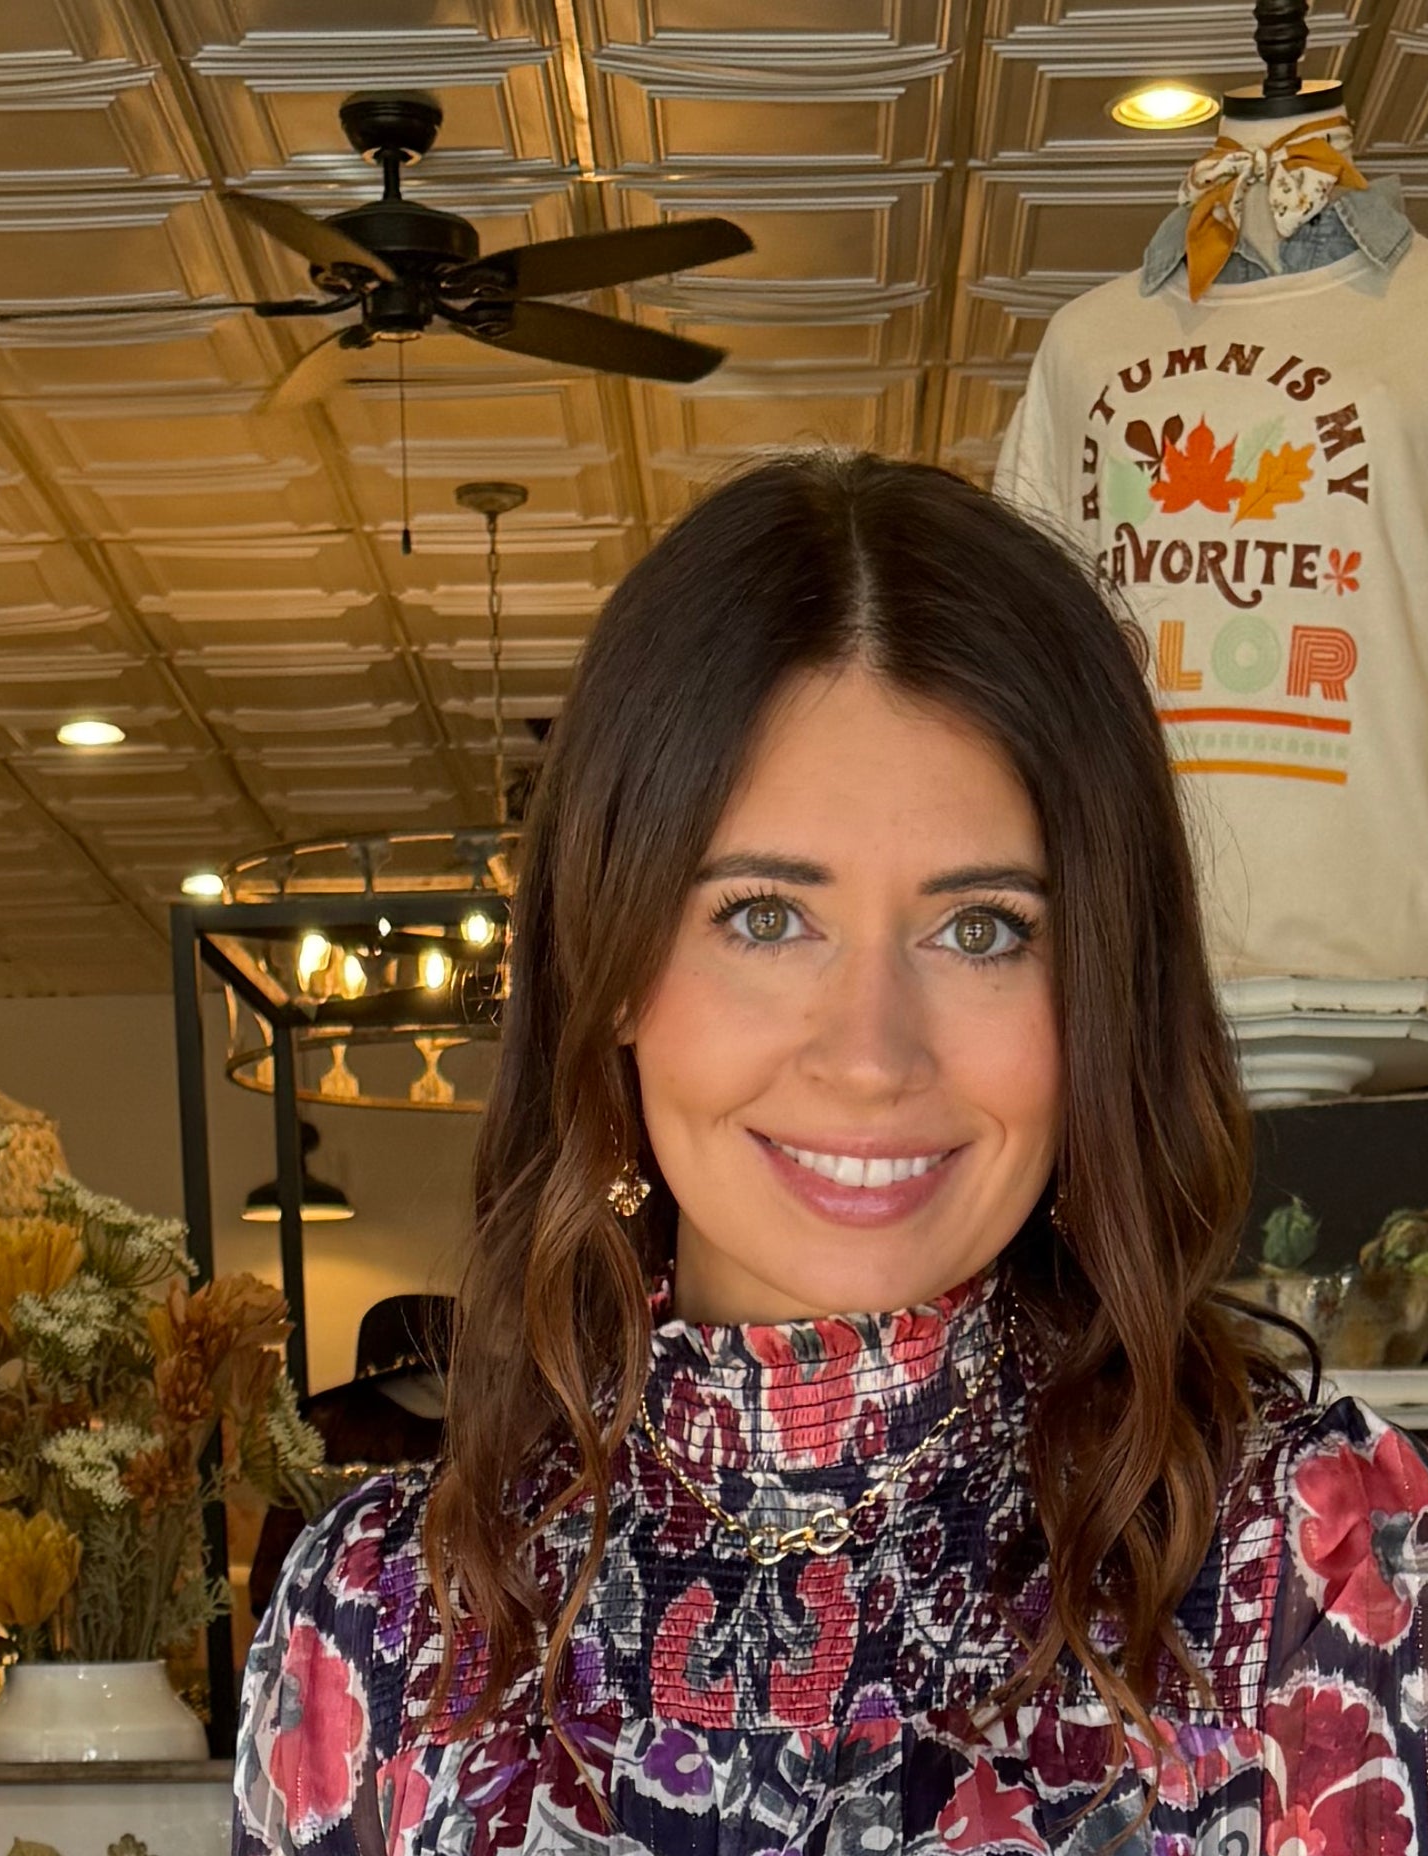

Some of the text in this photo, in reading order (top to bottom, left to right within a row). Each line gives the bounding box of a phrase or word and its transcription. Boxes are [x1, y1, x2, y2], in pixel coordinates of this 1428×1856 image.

[1082, 343, 1370, 521] AUTUMN IS MY
[1117, 613, 1358, 702] LOR
